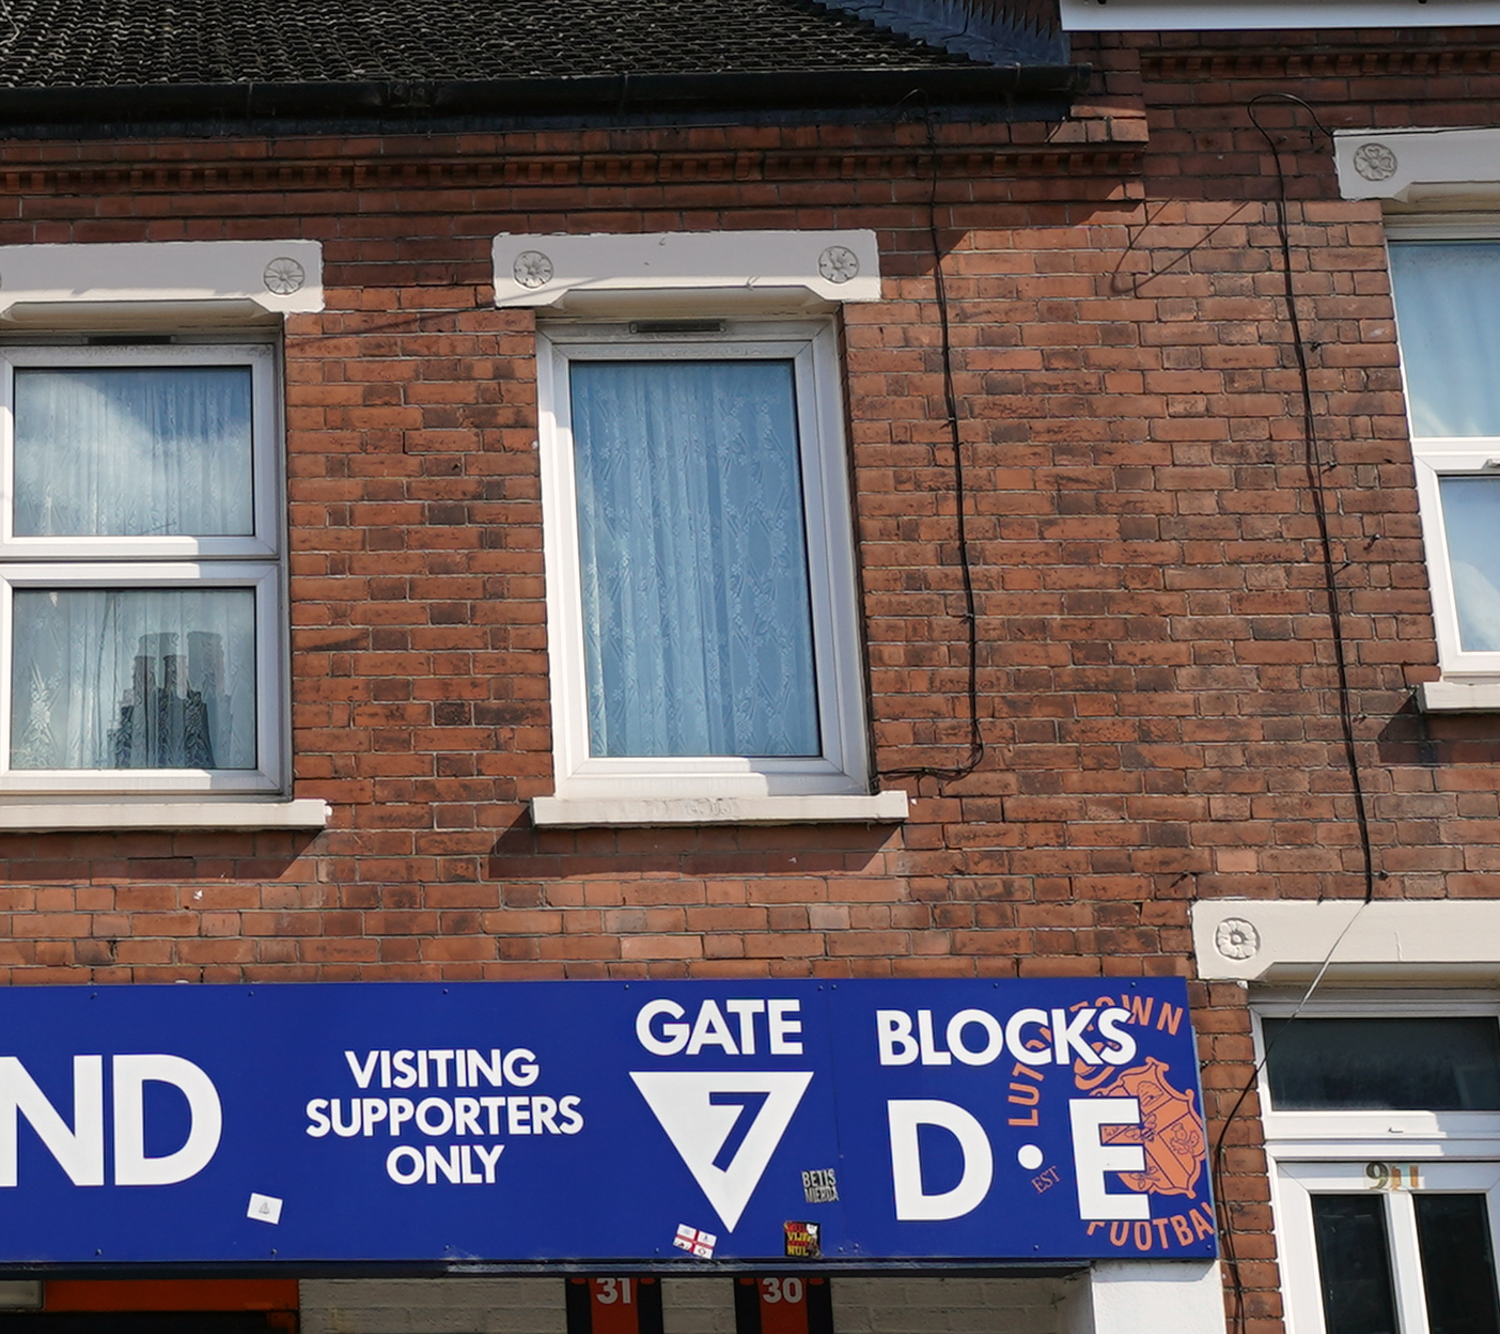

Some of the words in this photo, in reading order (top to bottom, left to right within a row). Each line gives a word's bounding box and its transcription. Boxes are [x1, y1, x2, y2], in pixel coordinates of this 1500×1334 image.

[637, 1000, 803, 1055] GATE
[877, 1008, 1136, 1065] BLOCKS
[345, 1049, 539, 1088] VISITING
[306, 1096, 583, 1137] SUPPORTERS
[708, 1091, 767, 1172] 7
[387, 1145, 504, 1185] ONLY
[802, 1168, 837, 1188] BETIS
[1031, 1166, 1061, 1194] EST
[596, 1277, 631, 1304] 31
[762, 1277, 803, 1304] 30
